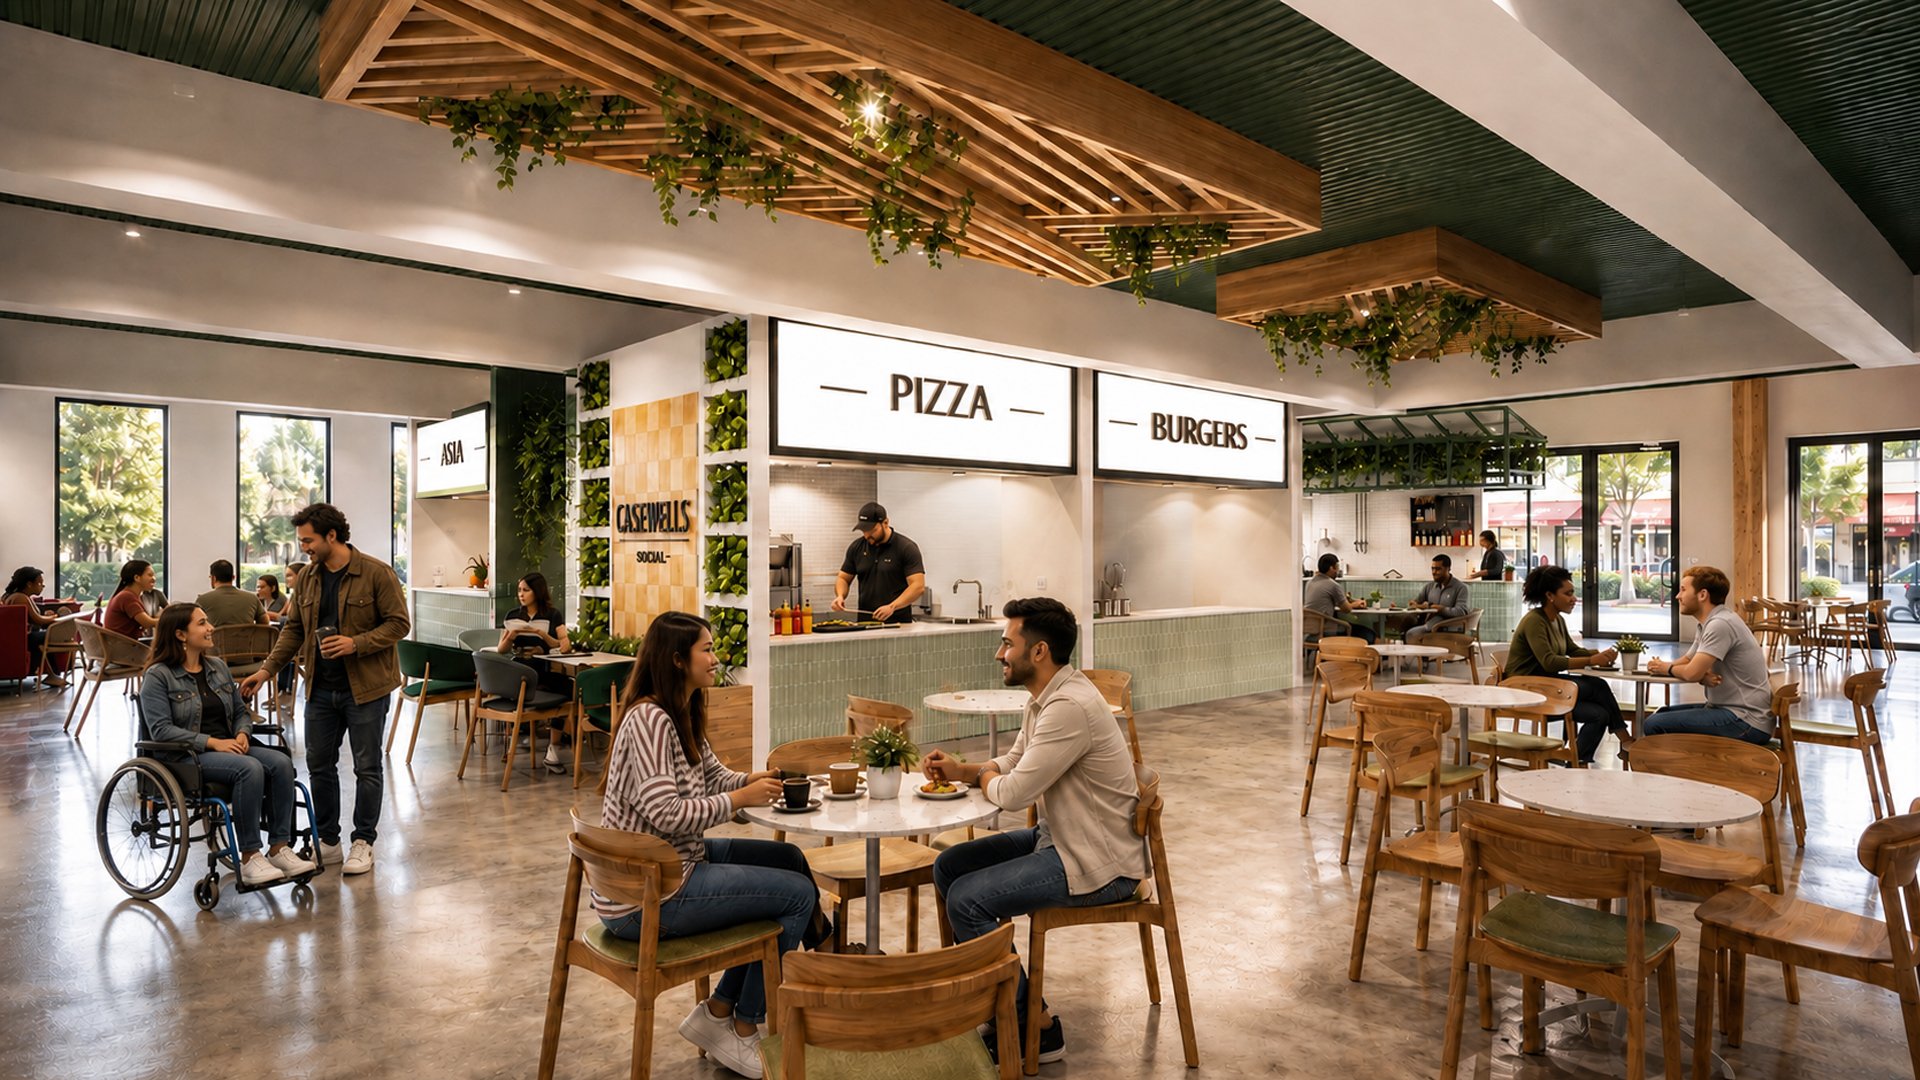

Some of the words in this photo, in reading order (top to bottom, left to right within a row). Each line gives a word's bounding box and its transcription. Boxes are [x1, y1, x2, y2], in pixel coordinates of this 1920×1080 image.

[890, 373, 993, 422] PIZZA
[1151, 412, 1249, 451] BURGERS
[440, 439, 465, 467] ASIA
